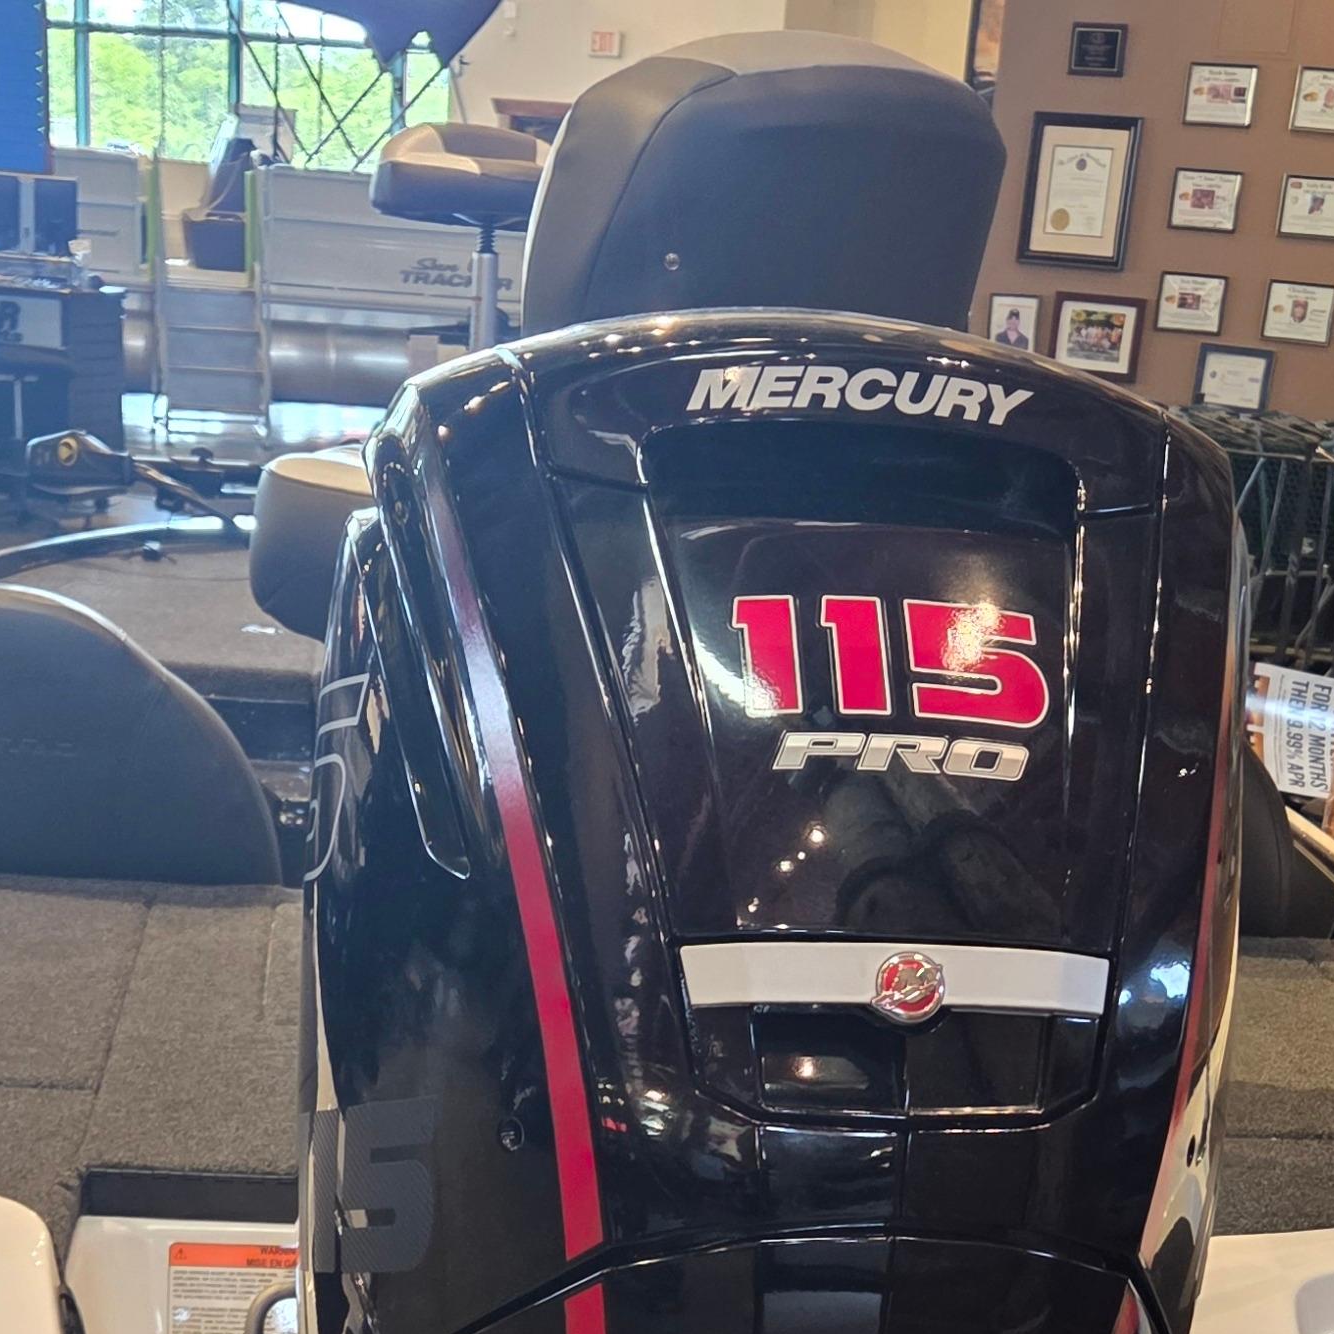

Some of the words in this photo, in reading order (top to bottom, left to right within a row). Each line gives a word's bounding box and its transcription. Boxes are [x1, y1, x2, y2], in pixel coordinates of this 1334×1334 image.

[399, 269, 514, 291] TRACR
[687, 365, 1034, 426] MERCURY
[731, 594, 1049, 729] 115
[1310, 683, 1332, 712] FOR
[772, 731, 1030, 781] PRO
[1286, 762, 1306, 788] APR
[1307, 733, 1328, 792] MONTHS
